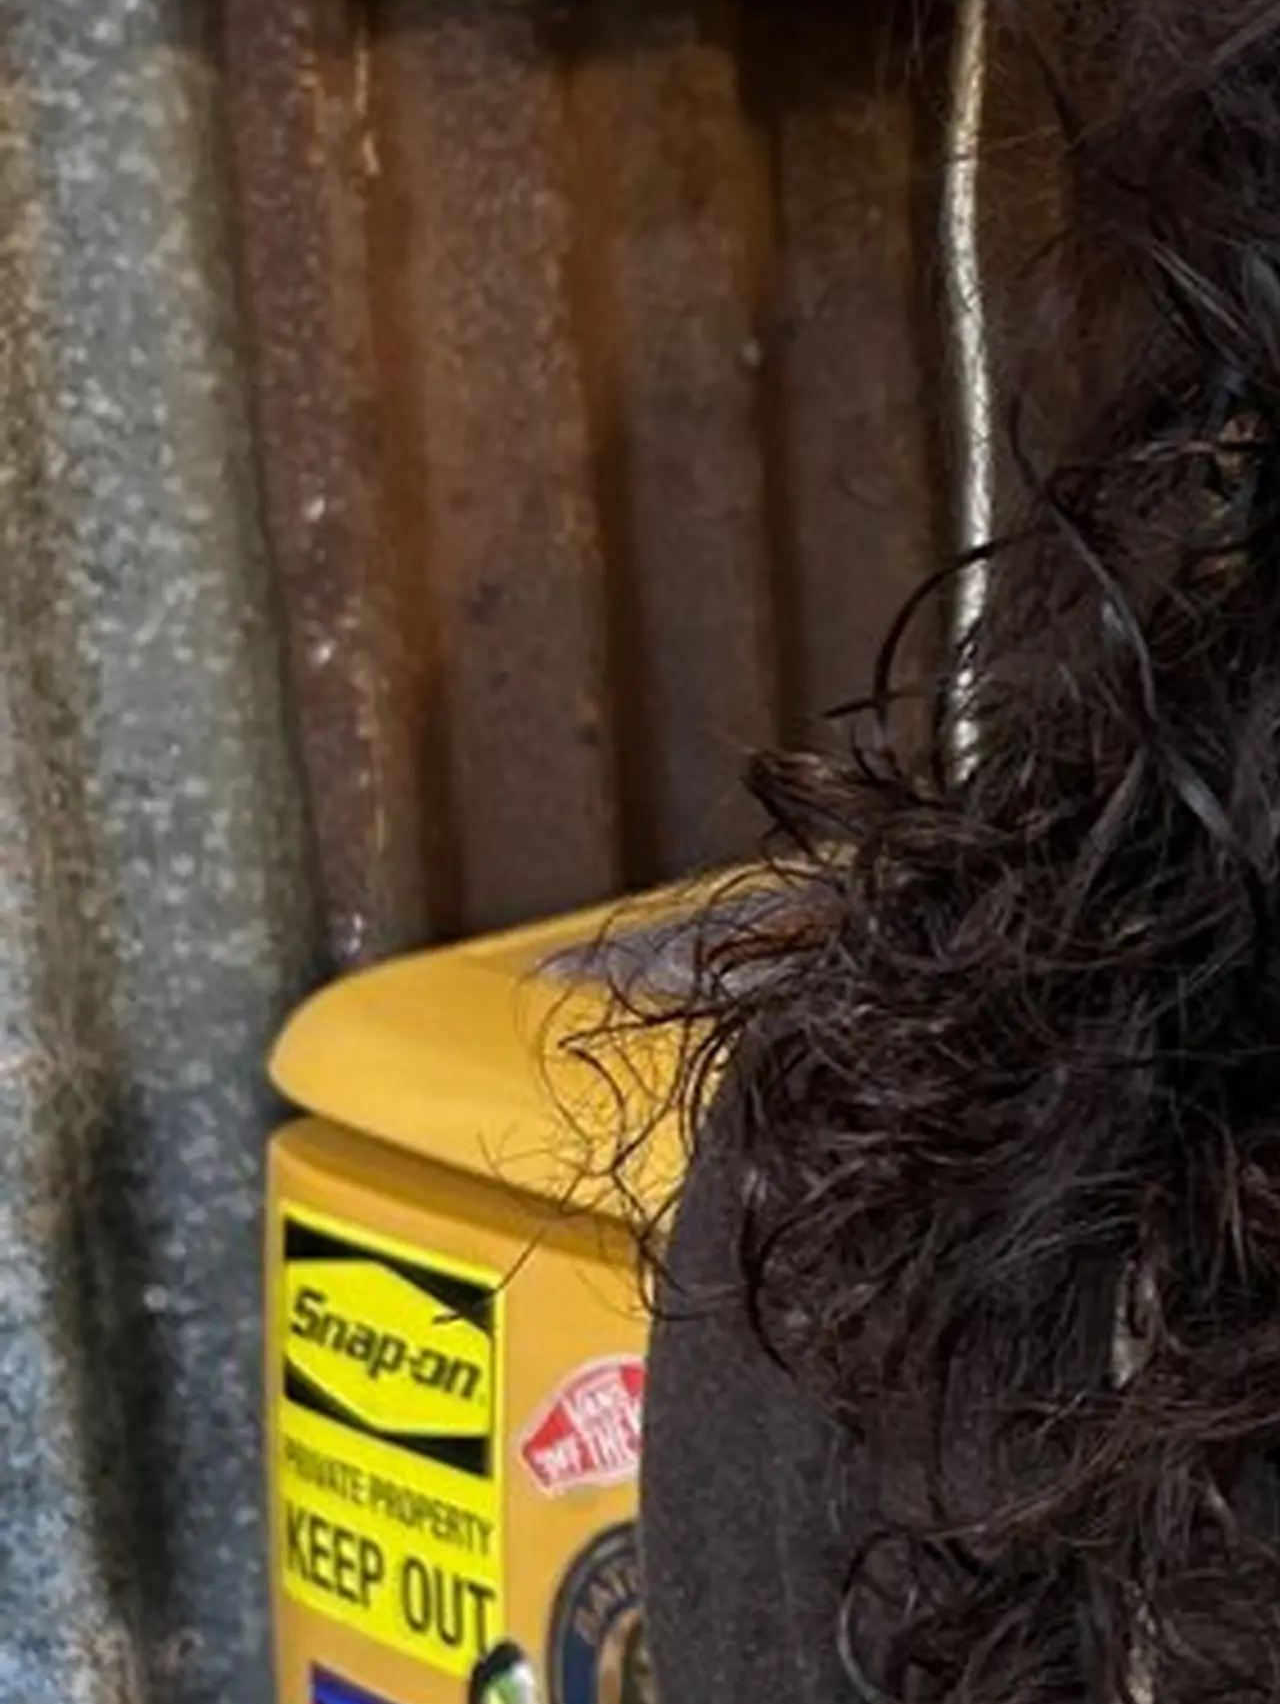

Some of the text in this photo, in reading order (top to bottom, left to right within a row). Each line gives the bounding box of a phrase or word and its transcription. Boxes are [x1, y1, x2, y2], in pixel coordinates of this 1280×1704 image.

[290, 1288, 483, 1402] Snap-on
[368, 1467, 494, 1558] PROPERTY
[284, 1502, 385, 1609] KEEP
[401, 1557, 498, 1656] OUT
